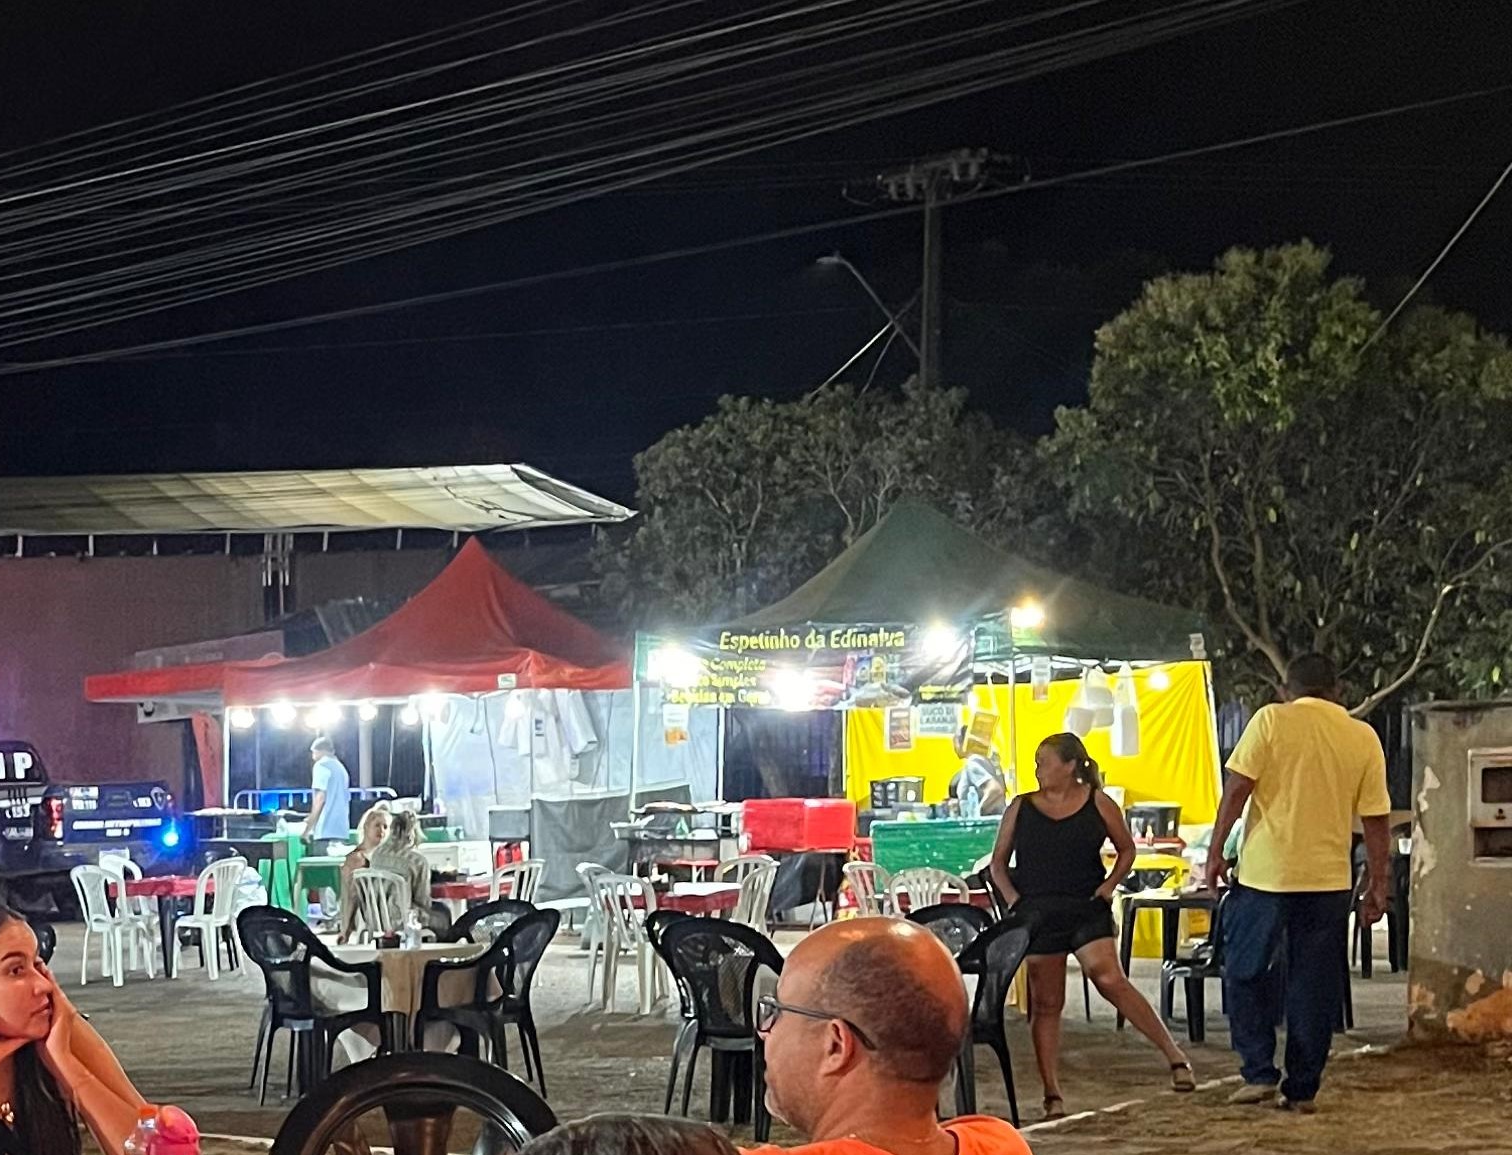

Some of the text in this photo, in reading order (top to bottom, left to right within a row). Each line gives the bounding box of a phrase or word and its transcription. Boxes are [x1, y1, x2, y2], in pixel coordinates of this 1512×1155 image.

[719, 628, 905, 653] Espetinho da Edinalva
